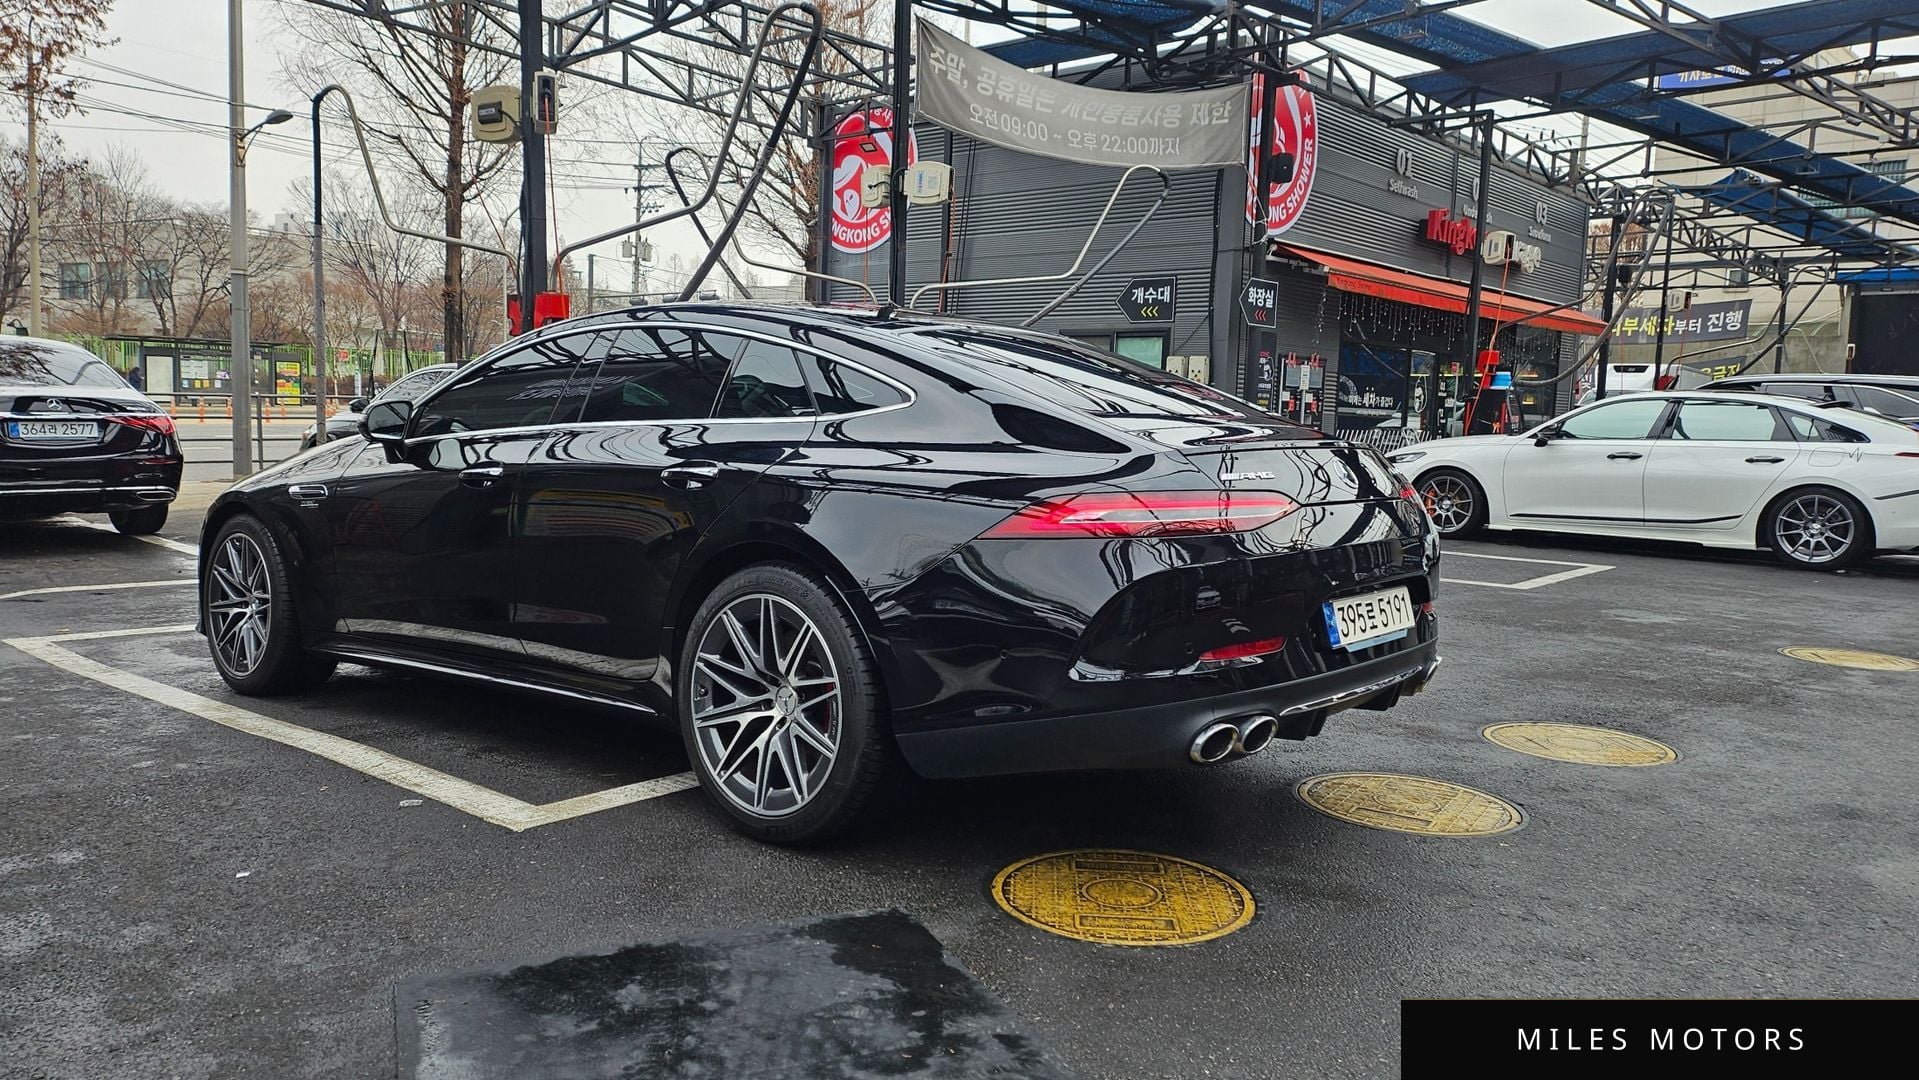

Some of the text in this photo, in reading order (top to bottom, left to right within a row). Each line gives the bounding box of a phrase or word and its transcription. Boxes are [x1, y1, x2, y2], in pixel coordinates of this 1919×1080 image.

[930, 46, 968, 89] 주말,
[976, 66, 1059, 113] 공휴일은
[1190, 101, 1231, 126] 제한
[1286, 137, 1313, 214] SHOWER
[1396, 148, 1412, 179] 01
[1473, 177, 1480, 201] 0
[1536, 201, 1548, 226] 03
[1131, 285, 1170, 304] 개수대
[1248, 286, 1274, 308] 화장실
[1707, 309, 1743, 333] 진행
[20, 423, 94, 436] 364라 2577
[1240, 471, 1276, 481] AMG
[1337, 591, 1411, 638] 395로 5191
